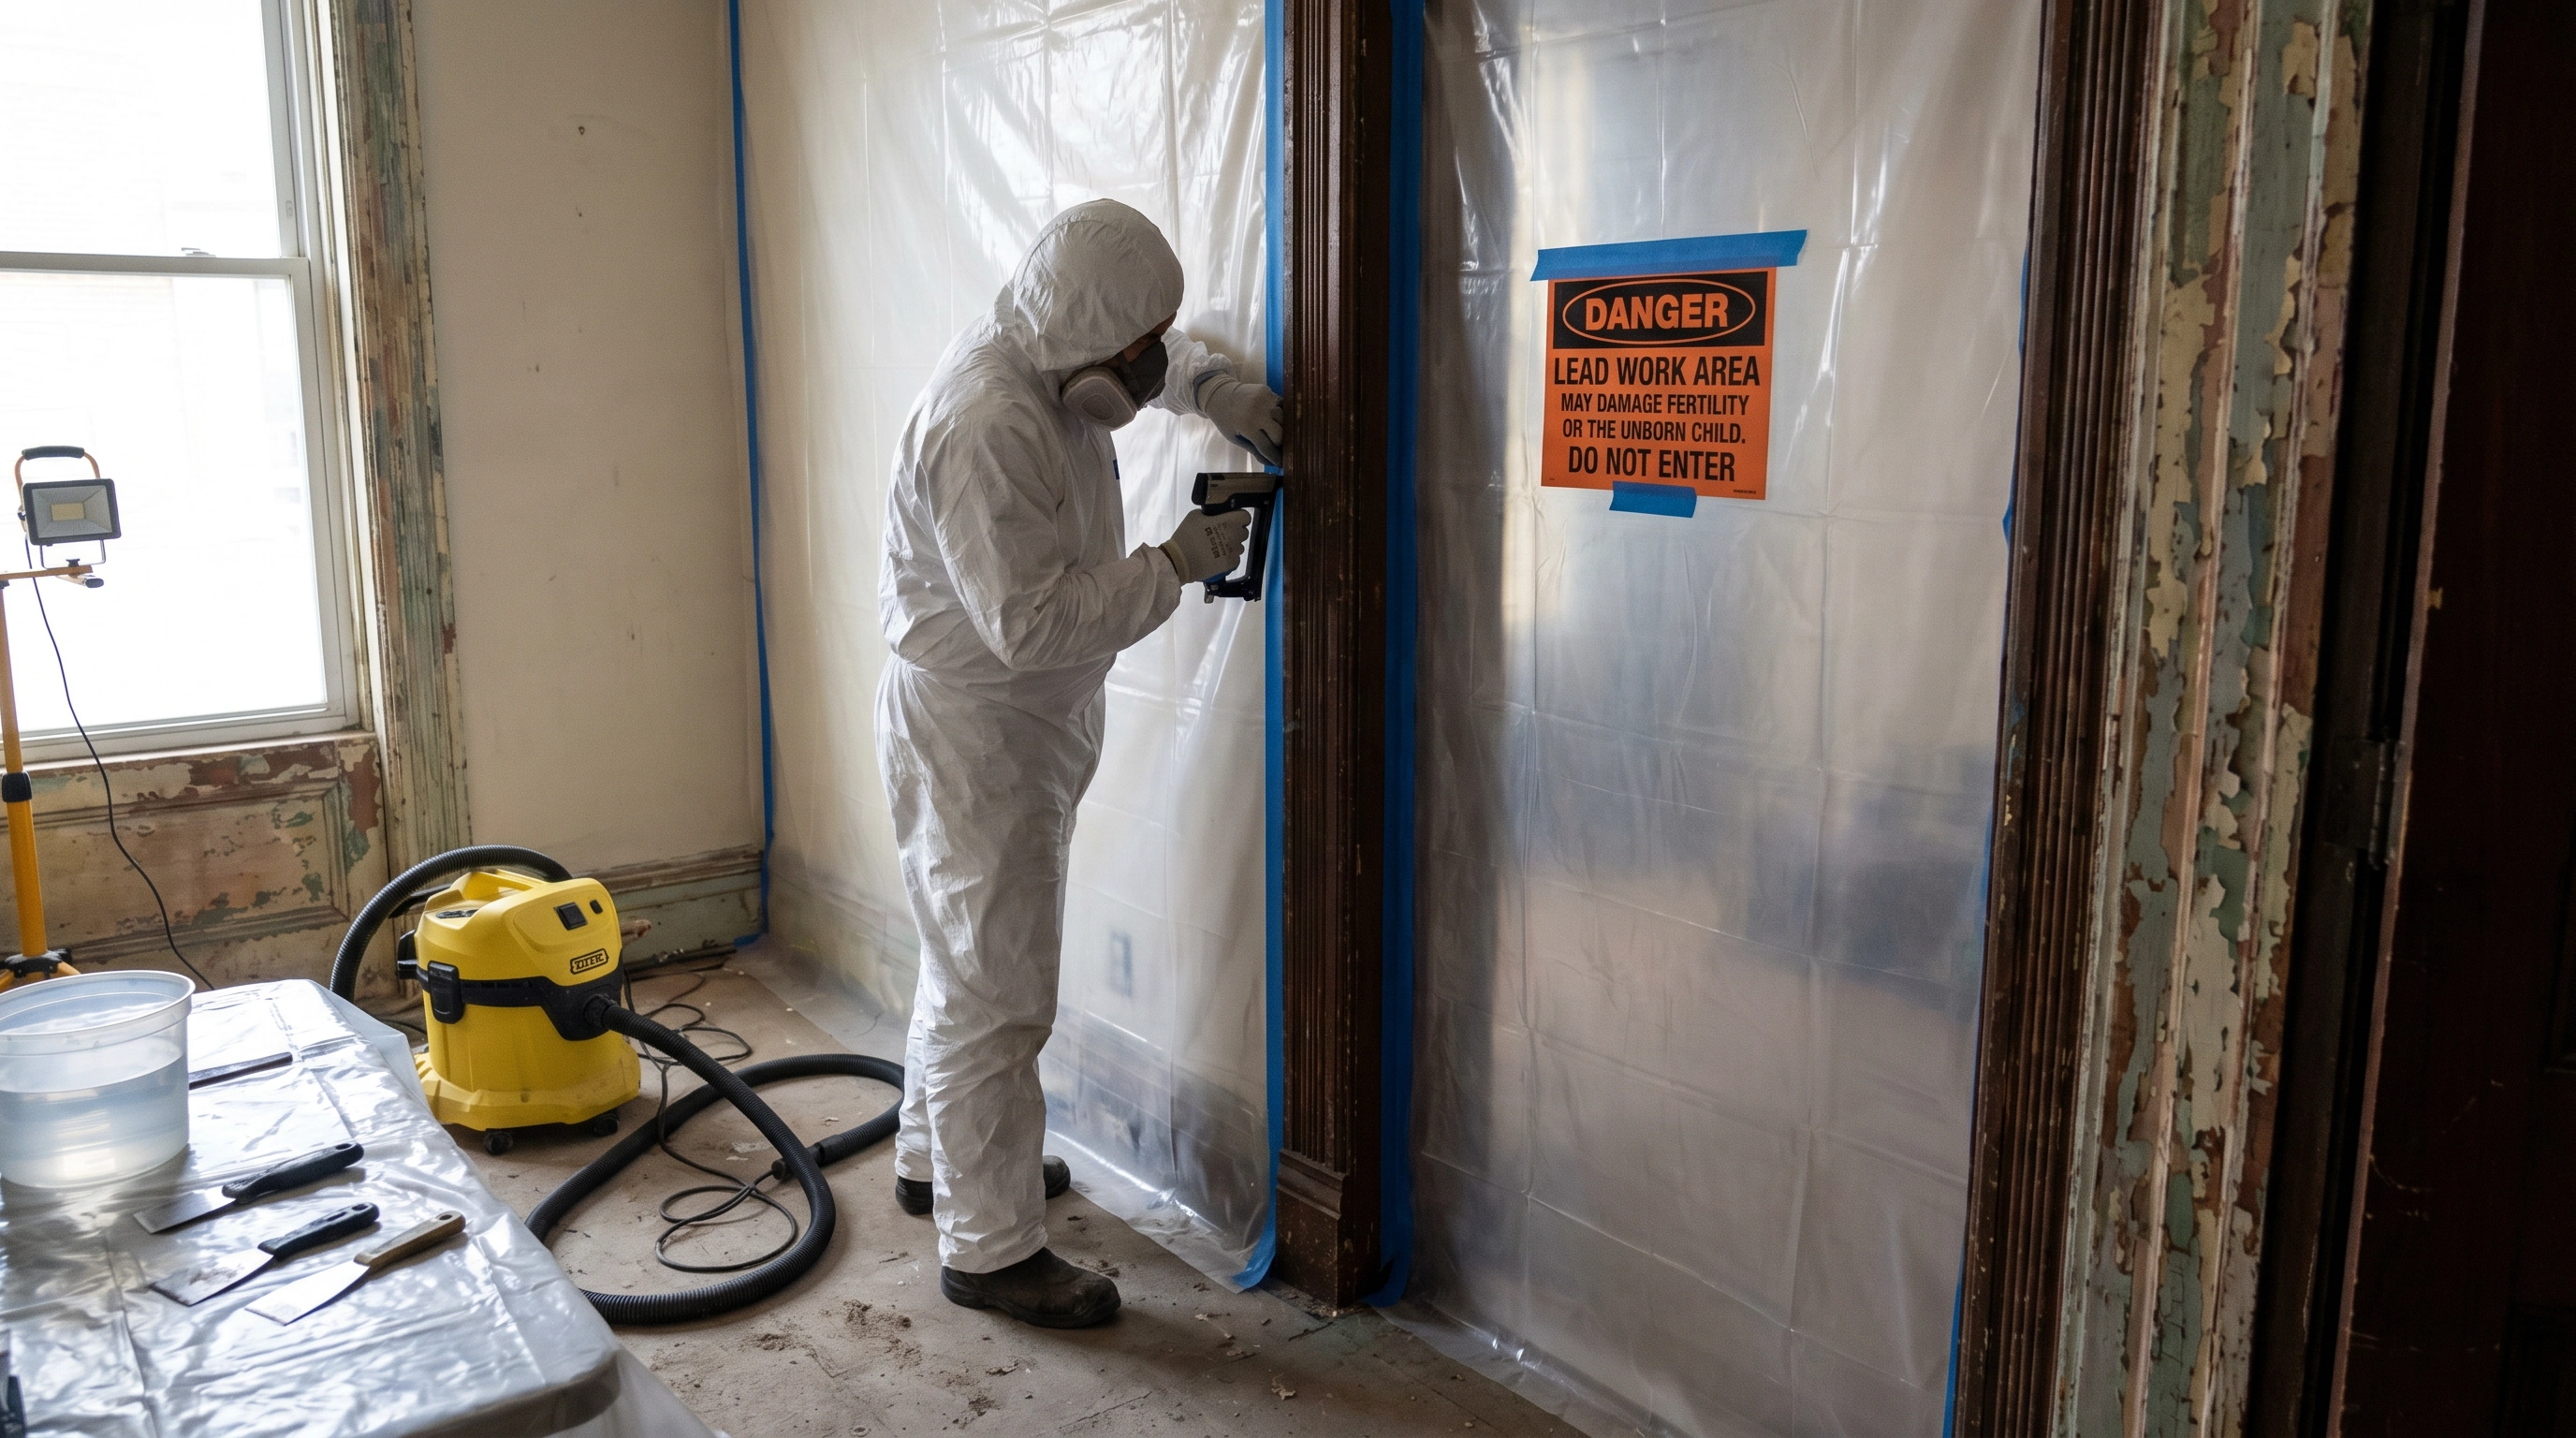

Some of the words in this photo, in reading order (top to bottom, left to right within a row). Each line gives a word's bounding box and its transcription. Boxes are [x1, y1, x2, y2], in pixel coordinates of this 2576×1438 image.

[1586, 293, 1729, 330] DANGER
[1555, 358, 1608, 385] LEAD
[1617, 357, 1686, 386] WORK
[1693, 356, 1760, 386] AREA
[1561, 393, 1592, 411] MAY
[1598, 394, 1662, 413] DAMAGE
[1668, 394, 1749, 415] FERTILITY
[1563, 418, 1582, 437] OR
[1588, 419, 1616, 438] THE
[1621, 420, 1686, 441] UNBORN
[1692, 422, 1745, 444] CHILD.
[1569, 447, 1598, 474] DO
[1606, 448, 1651, 477] NOT
[1659, 449, 1734, 481] ENTER
